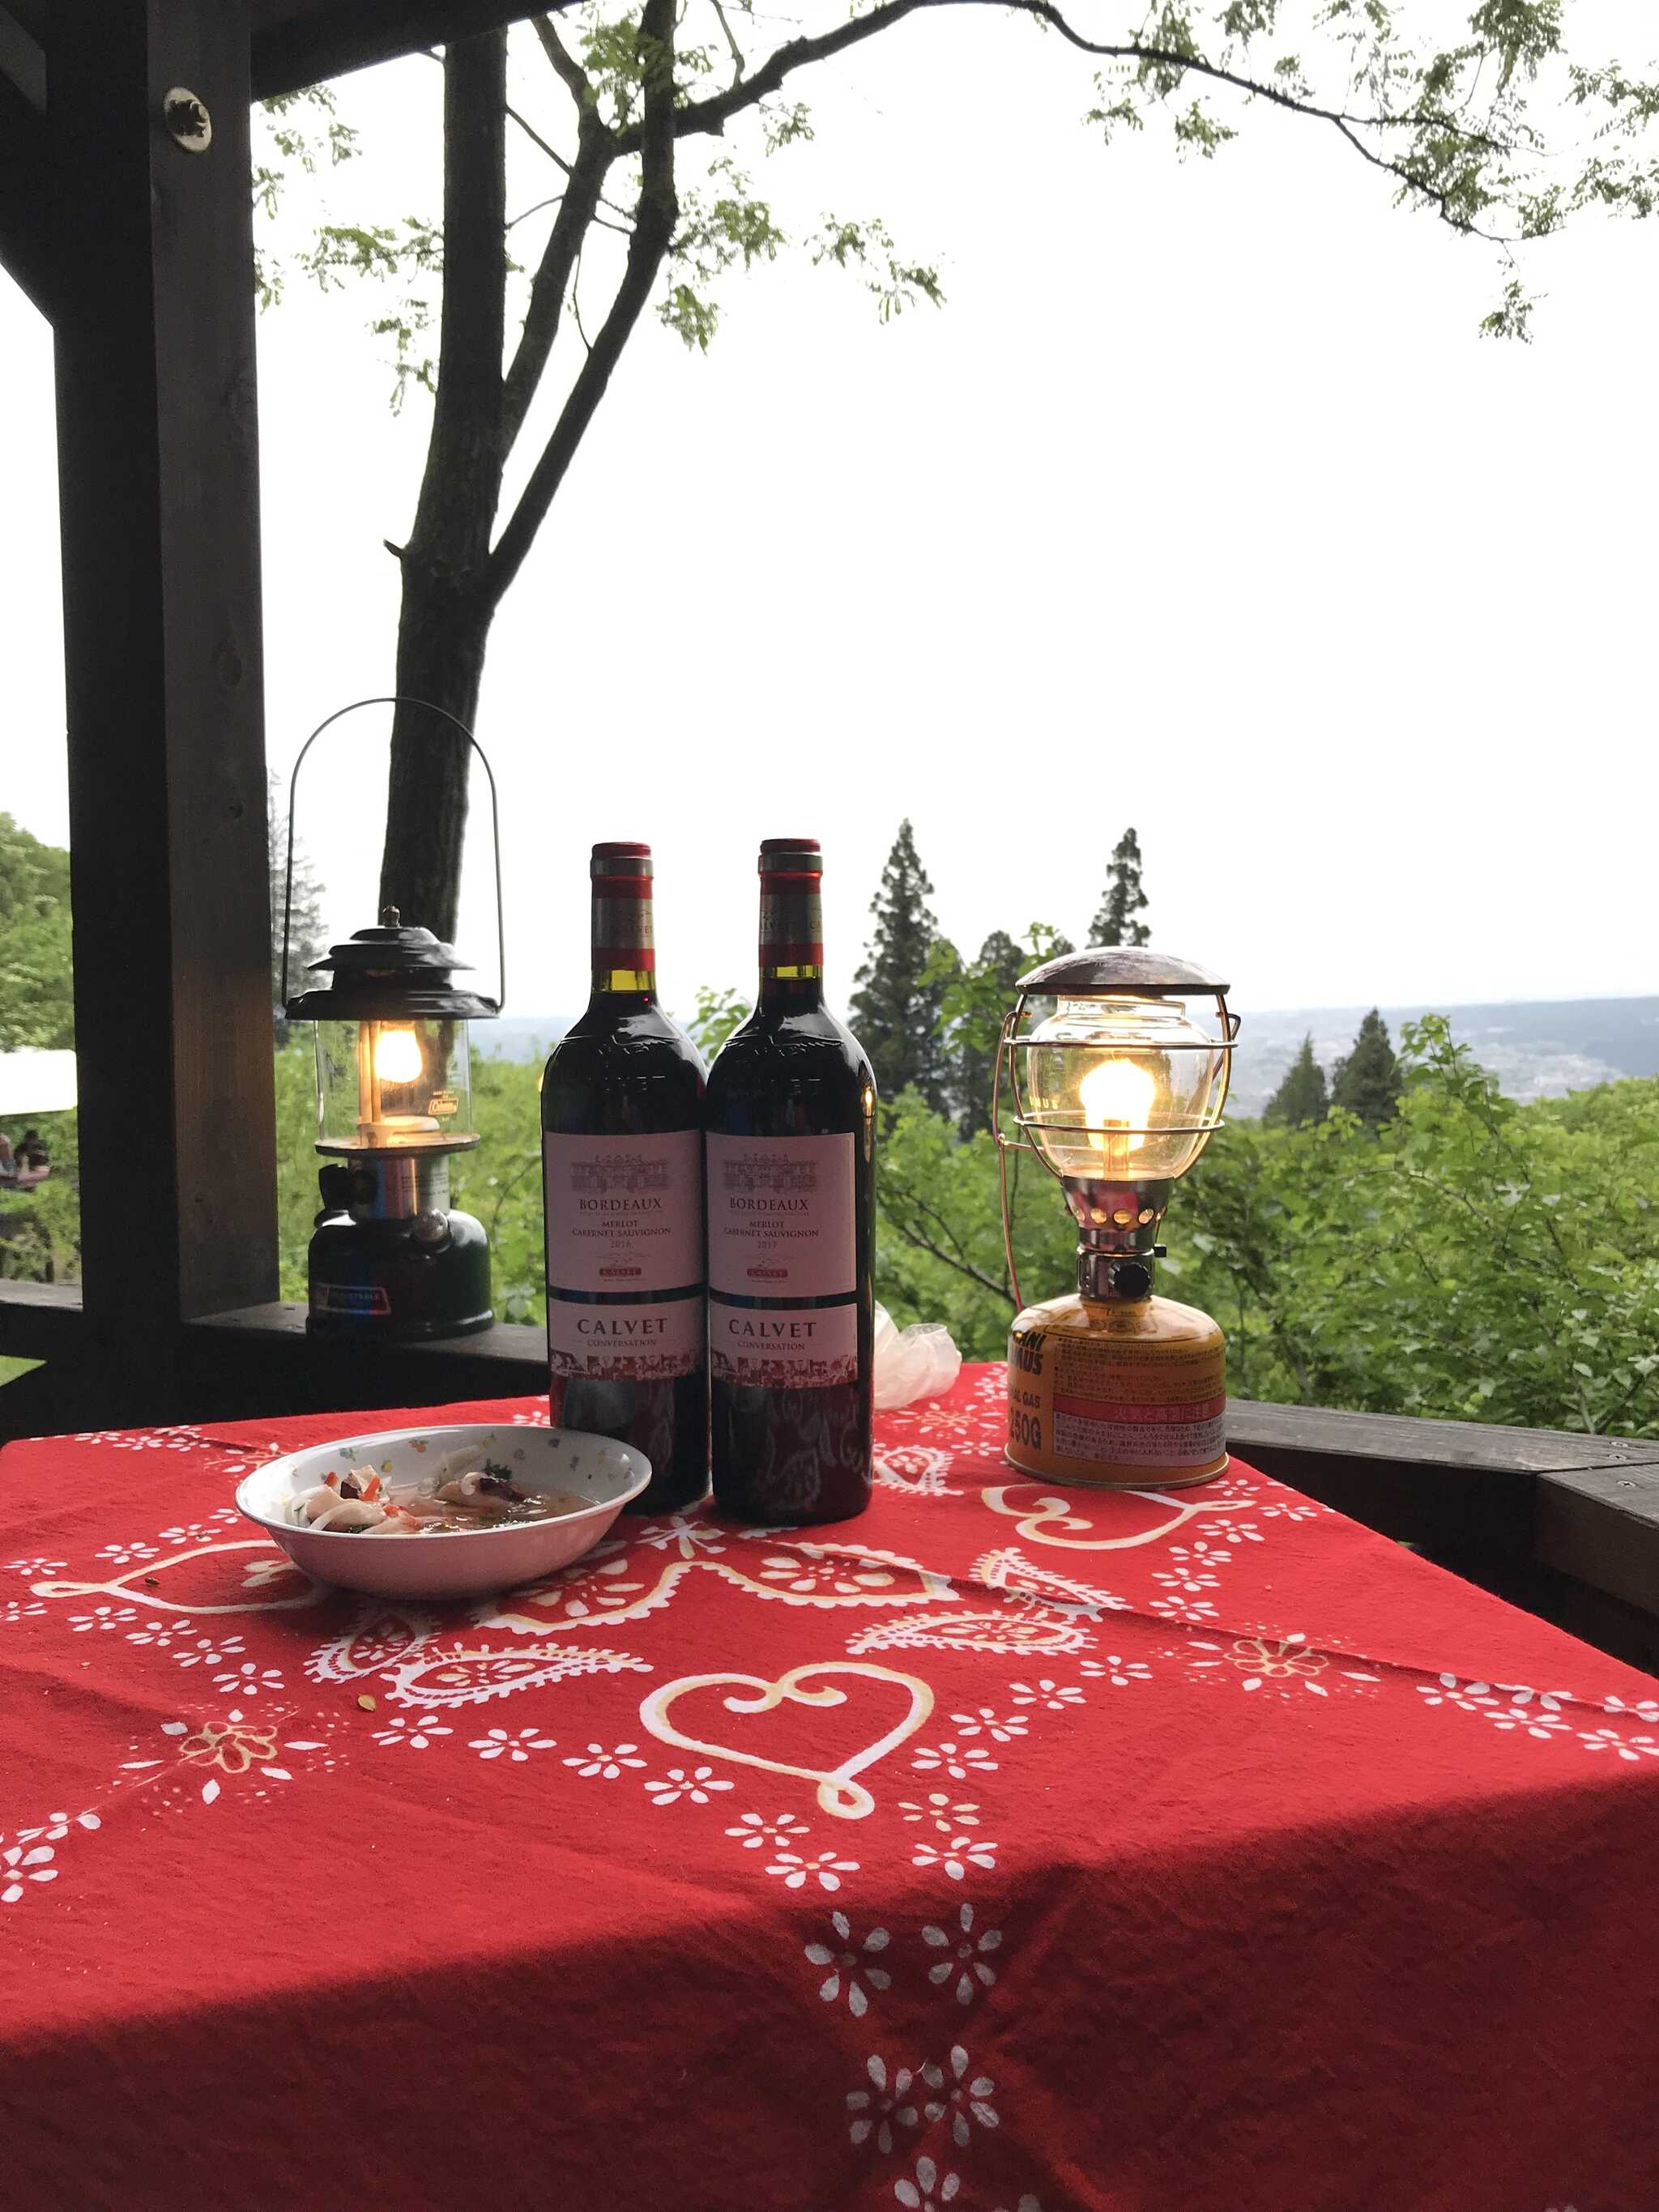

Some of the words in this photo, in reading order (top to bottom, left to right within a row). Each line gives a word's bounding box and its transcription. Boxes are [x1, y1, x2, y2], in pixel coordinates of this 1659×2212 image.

[578, 1198, 662, 1211] BORDEAUX
[729, 1196, 809, 1211] BORDEAUX
[602, 1220, 638, 1228] MERLOT
[748, 1221, 785, 1229] MERLOT
[617, 1226, 672, 1238] SAUVIGNON
[763, 1230, 820, 1238] SAUVIGNON
[576, 1318, 667, 1335] CALVET
[729, 1319, 817, 1338] CALVET
[586, 1339, 658, 1348] CONVERSATION
[736, 1341, 806, 1351] CONVERSATION
